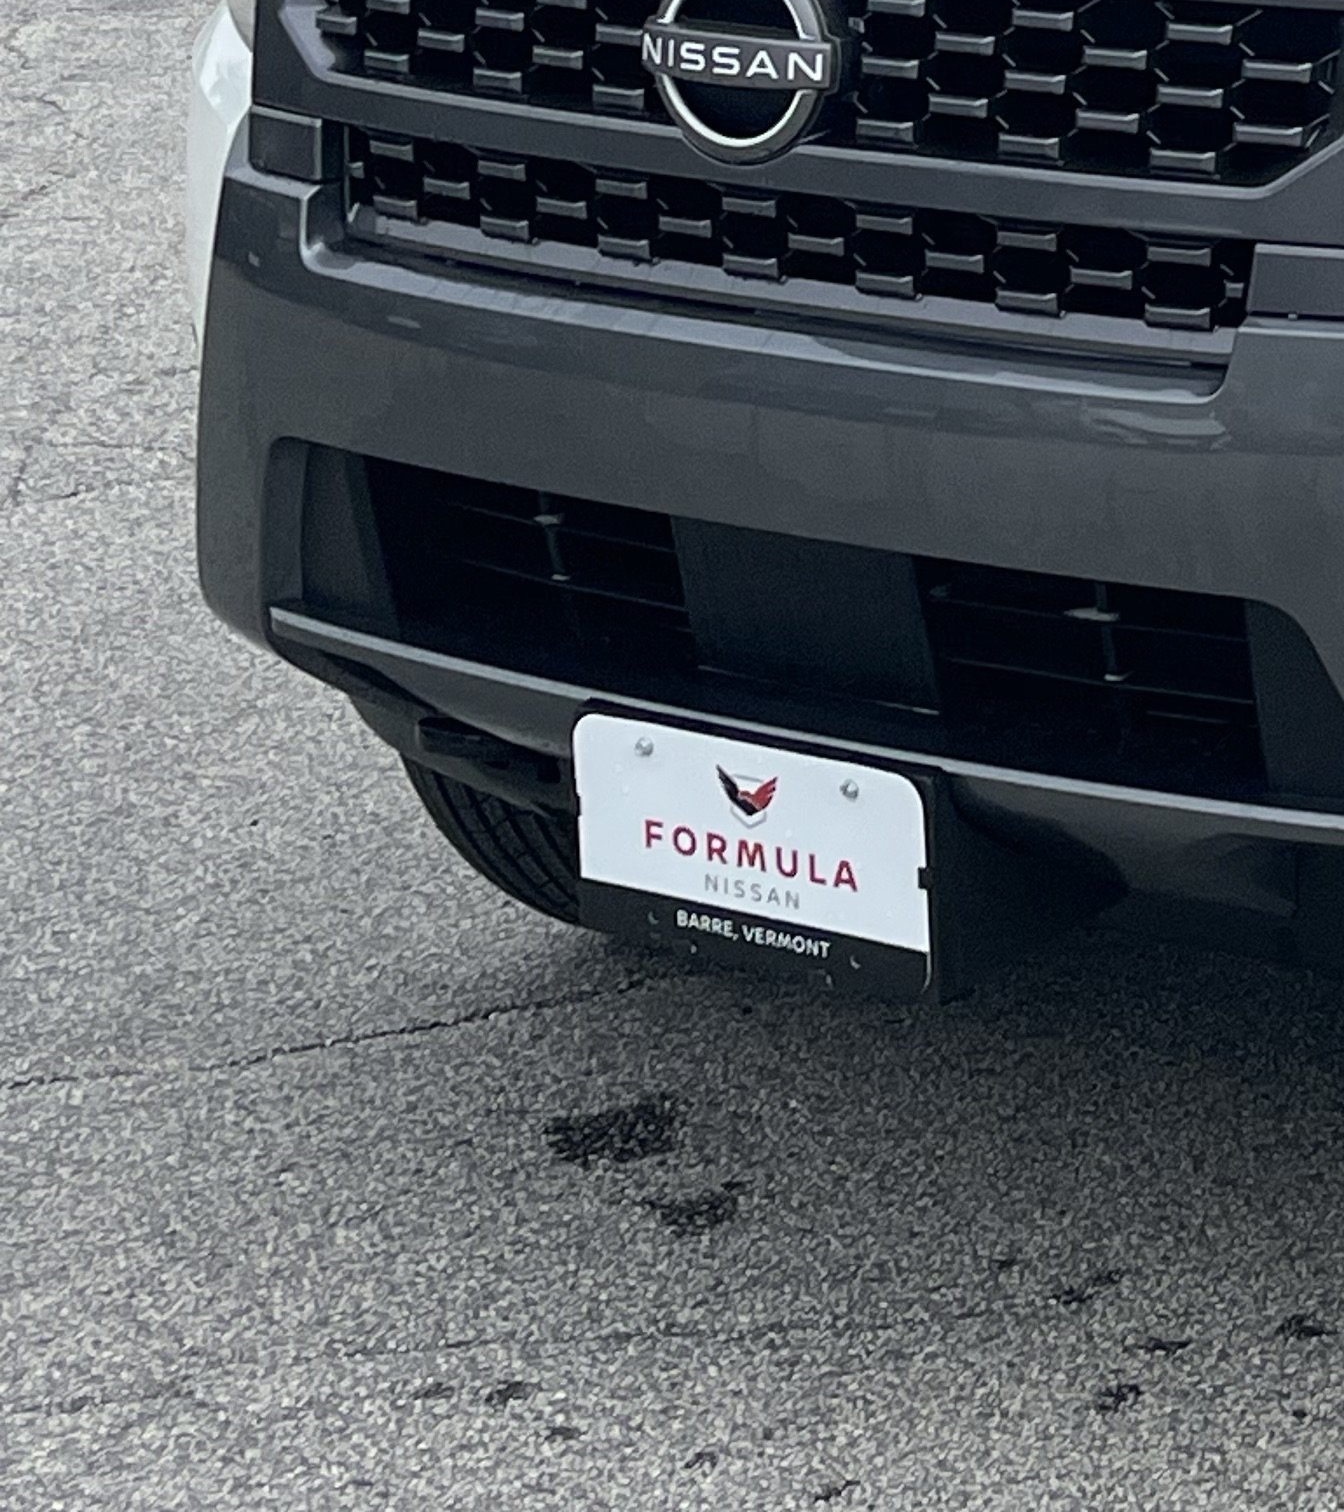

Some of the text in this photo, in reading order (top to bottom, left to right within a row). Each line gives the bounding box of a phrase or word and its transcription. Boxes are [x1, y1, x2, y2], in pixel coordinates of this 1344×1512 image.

[642, 33, 824, 81] NISSAN
[644, 819, 859, 892] FORMULA
[704, 873, 800, 909] NISSAN
[676, 909, 832, 959] BARRE, VERMONT
